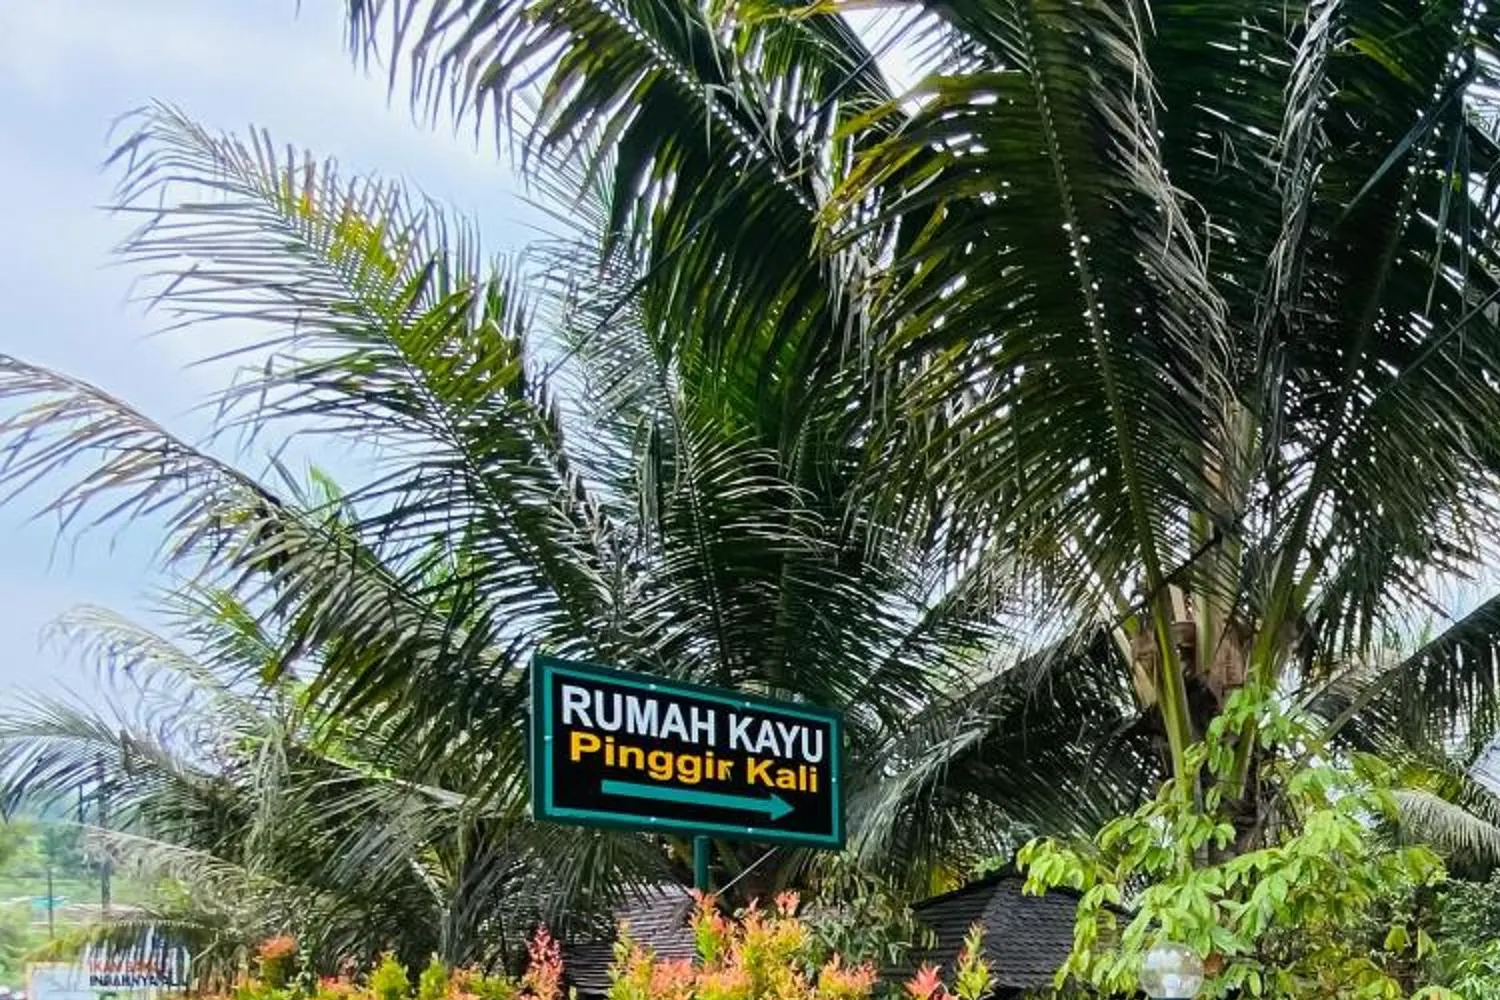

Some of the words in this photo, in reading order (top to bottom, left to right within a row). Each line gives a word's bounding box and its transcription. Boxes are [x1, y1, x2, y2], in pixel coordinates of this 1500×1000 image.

[561, 683, 715, 746] RUMAH
[729, 712, 824, 763] KAYU
[570, 730, 734, 784] Pinggir
[747, 757, 818, 793] Kali
